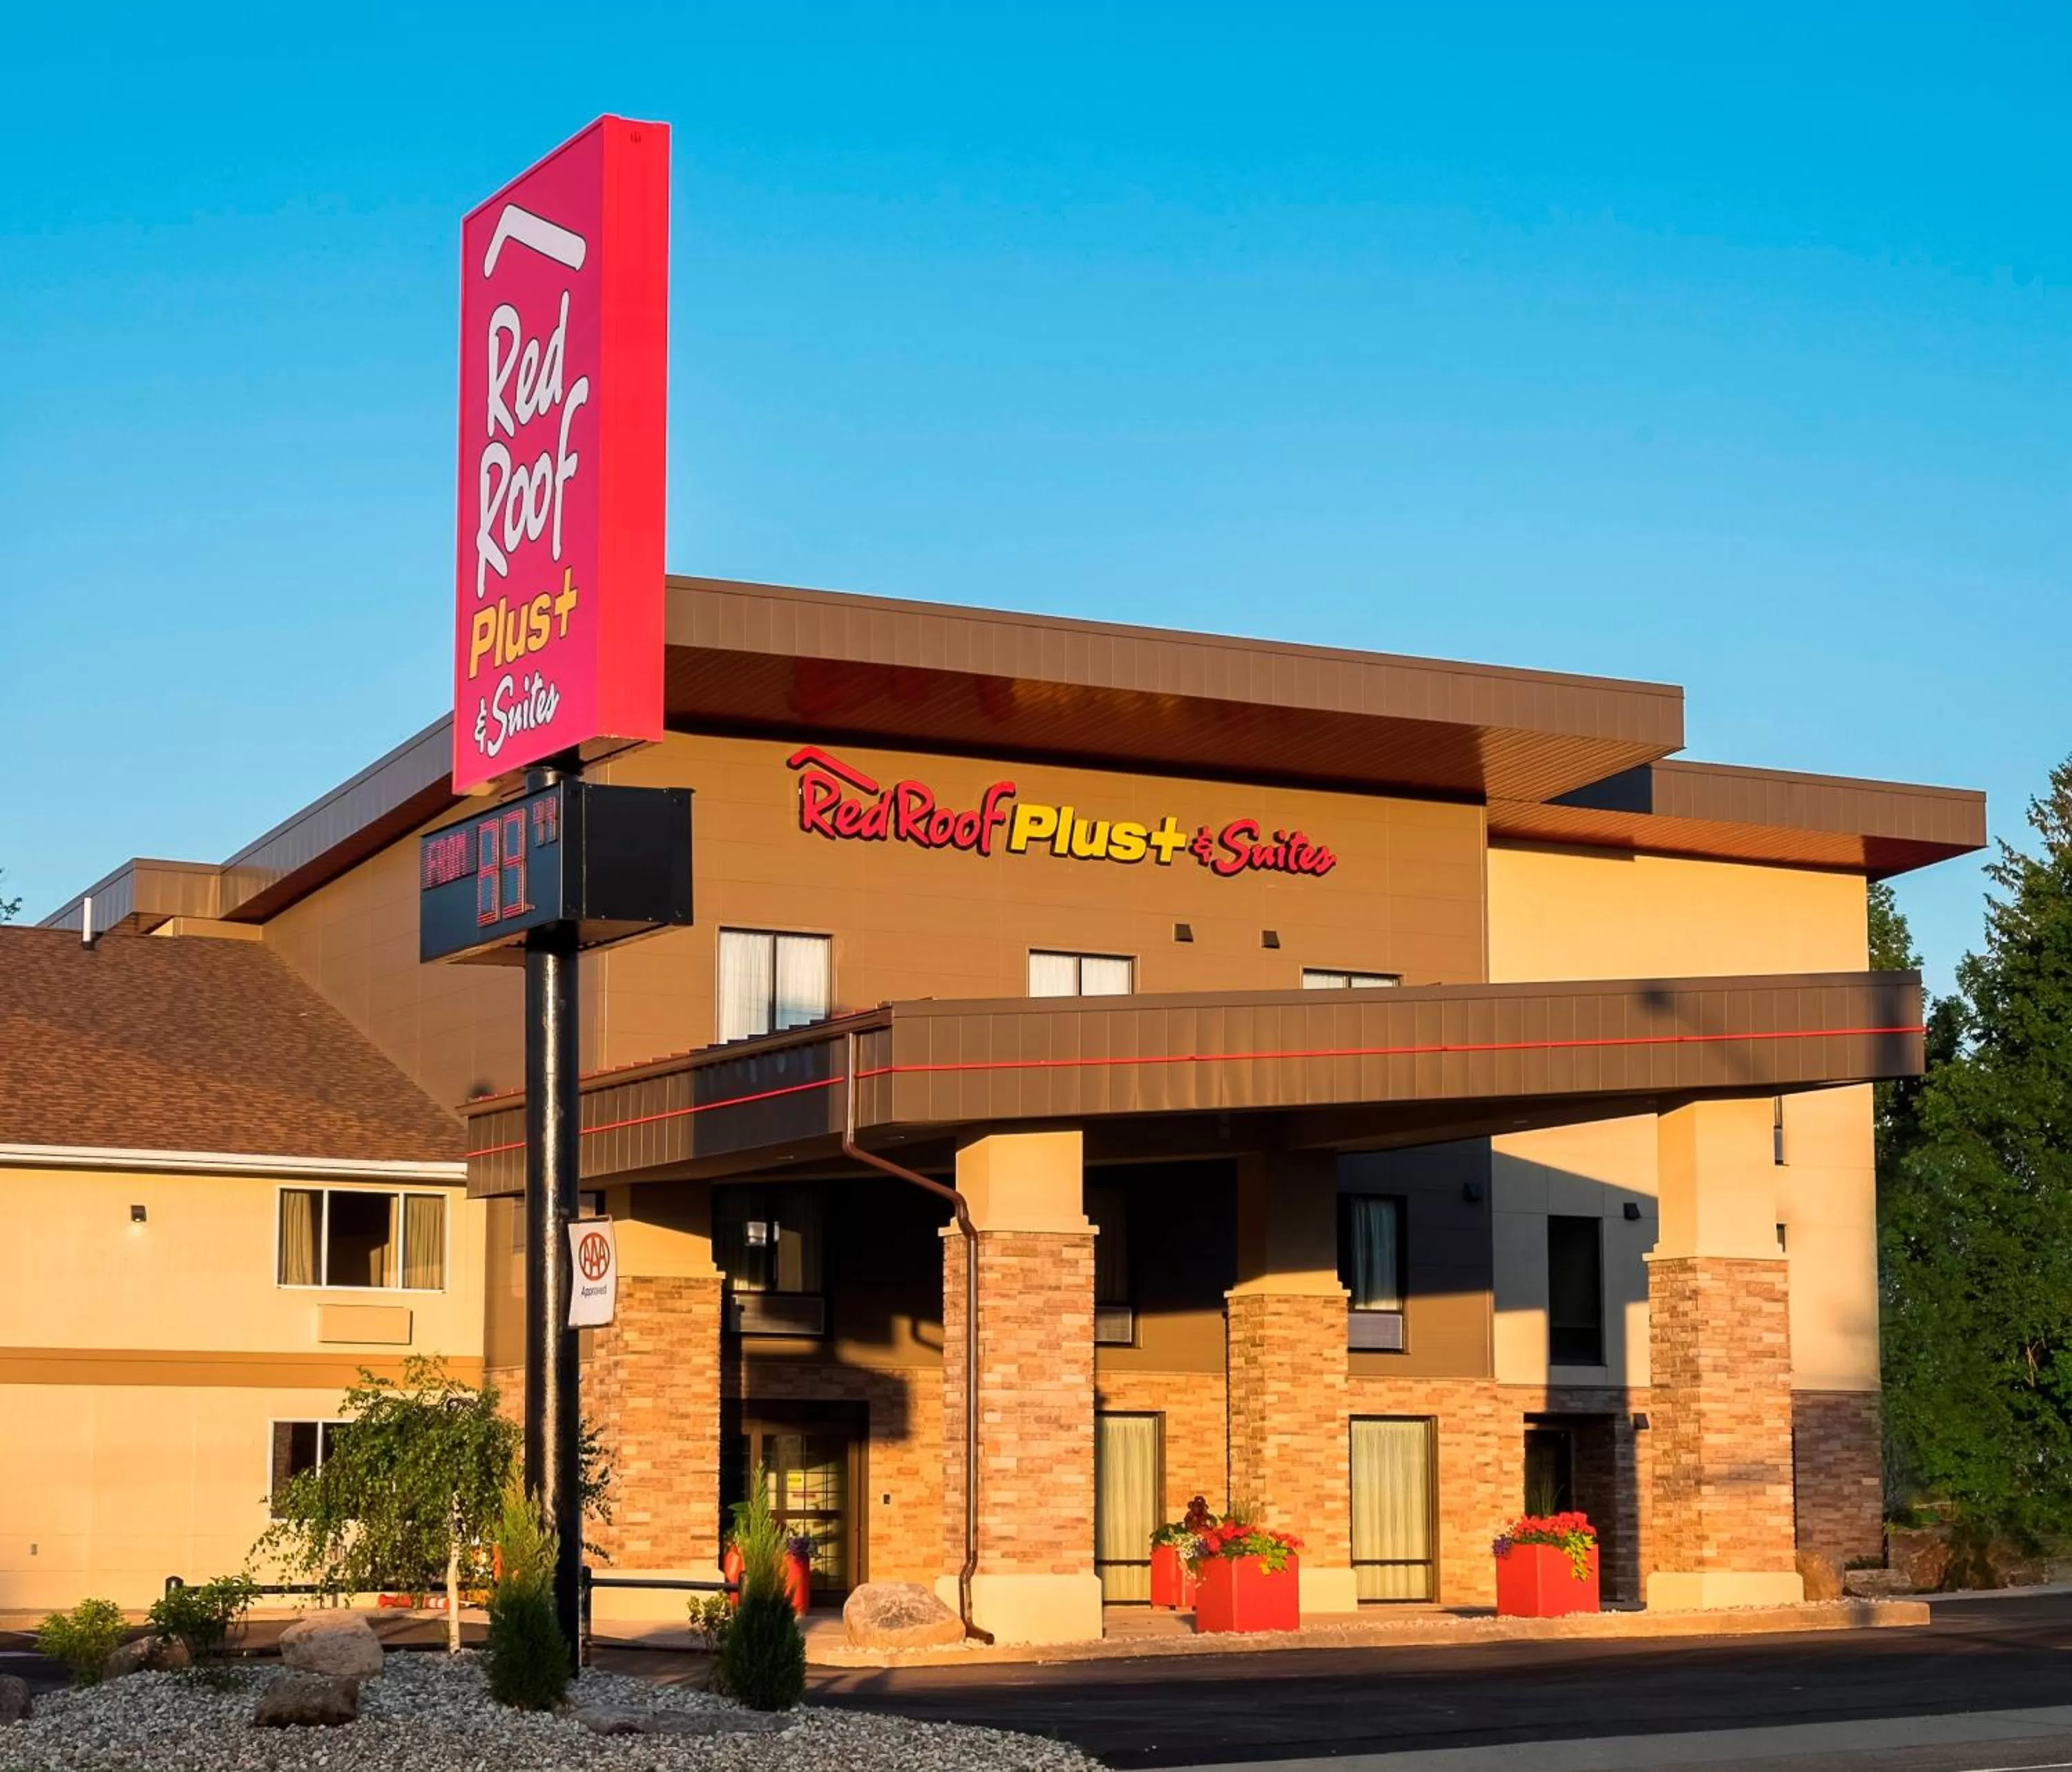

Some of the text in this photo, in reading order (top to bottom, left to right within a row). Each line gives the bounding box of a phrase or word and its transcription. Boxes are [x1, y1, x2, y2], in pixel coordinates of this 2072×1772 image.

[486, 289, 570, 438] Red
[476, 376, 588, 599] Roof
[467, 566, 578, 680] Plus+
[487, 671, 560, 757] Suites
[798, 769, 894, 841] Red
[894, 780, 1017, 856] Roof
[1006, 803, 1187, 865] Plus+
[1211, 818, 1338, 877] Suites
[581, 1233, 609, 1279] AAA
[581, 1285, 607, 1298] Approved
